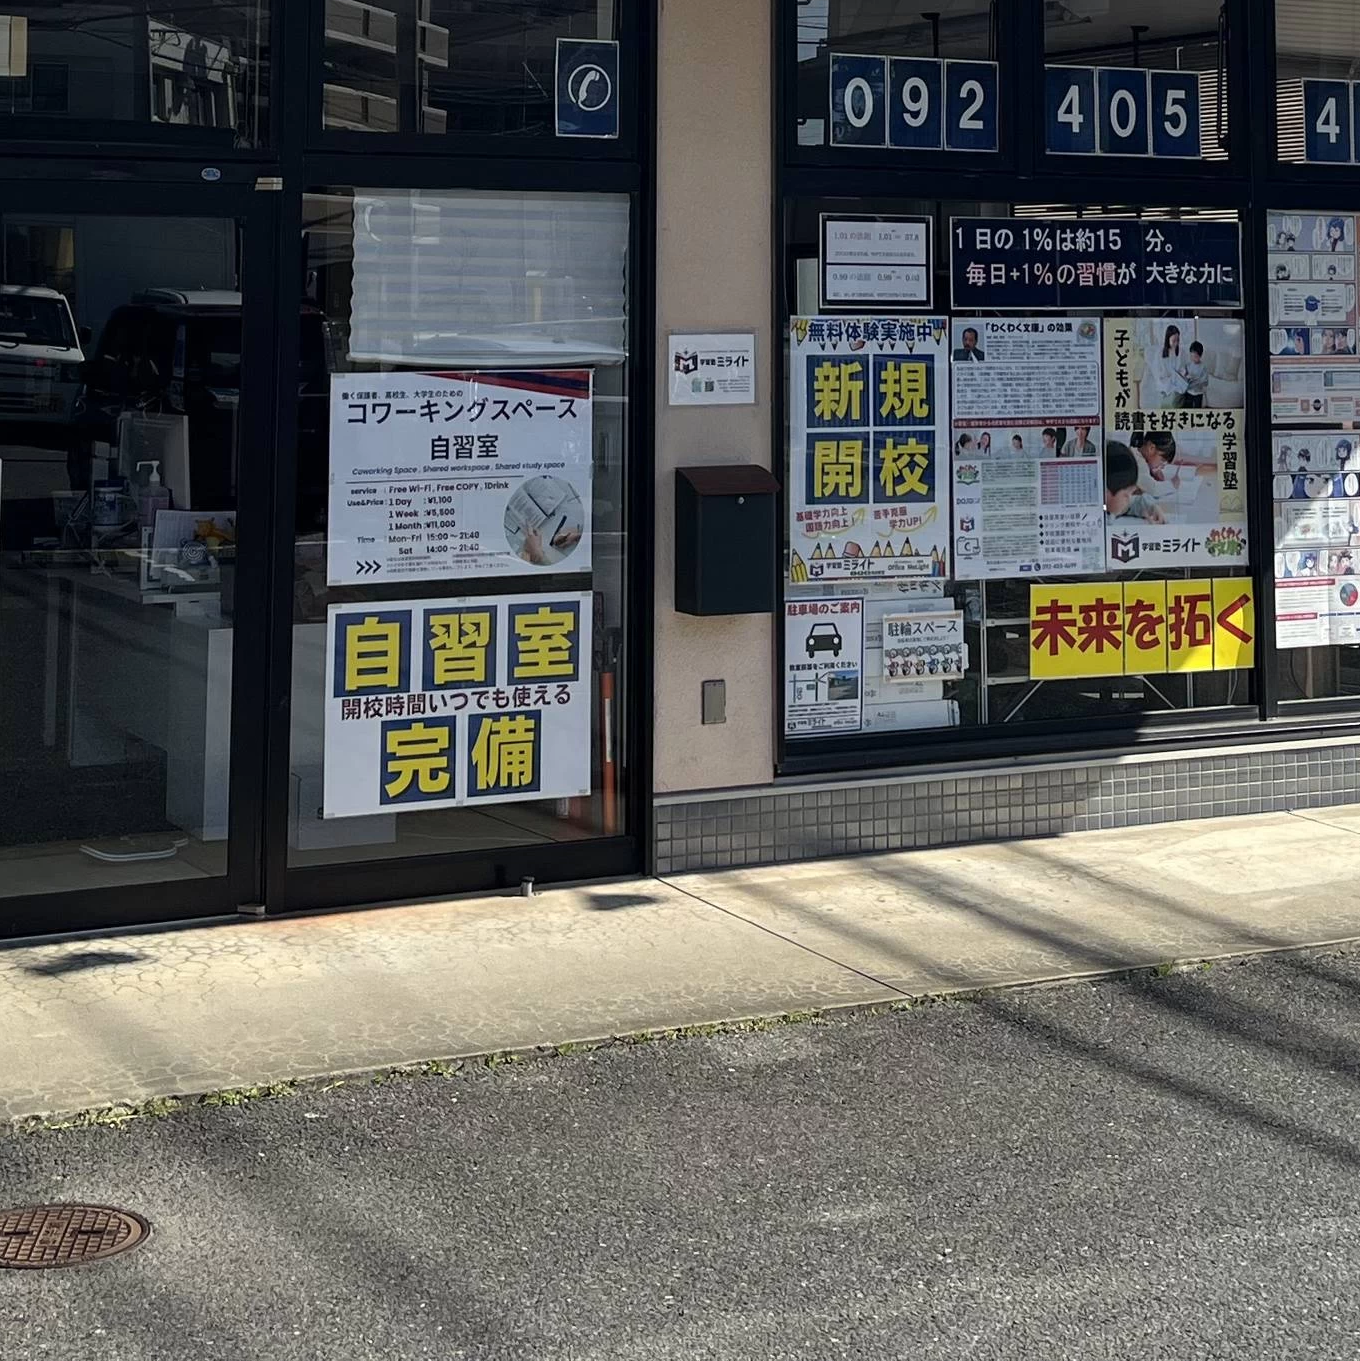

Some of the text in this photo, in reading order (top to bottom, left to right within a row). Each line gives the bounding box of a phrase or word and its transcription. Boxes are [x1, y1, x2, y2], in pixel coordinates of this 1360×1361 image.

[1145, 261, 1234, 284] 大きな力に
[808, 322, 933, 342] 無料体験実施中
[717, 355, 750, 368] ミライト
[1114, 329, 1131, 408] 子どもが
[813, 361, 930, 421] 新規
[347, 397, 578, 425] コワーキングスペース
[1114, 411, 1236, 431] 読書を好きになる
[430, 434, 499, 461] 自習室
[422, 464, 449, 473] Shared
[495, 461, 521, 471] Shared
[522, 461, 543, 471] study
[813, 437, 930, 499] 開校
[1222, 432, 1239, 491] 学習塾
[389, 486, 408, 494] Free
[395, 498, 412, 507] Day
[395, 510, 419, 518] Week
[795, 506, 849, 522] 基礎学力向上
[395, 522, 422, 530] Month
[398, 547, 413, 555] Sat
[1162, 538, 1201, 552] ミライト
[843, 557, 875, 571] ミライト
[787, 602, 861, 617] 駐車場のご案内
[887, 620, 958, 637] 駐輪スペース
[1031, 593, 1253, 656] 未来を拓く
[345, 607, 575, 691] 自習室
[341, 684, 572, 721] 開校時間いつでも使える
[384, 715, 535, 798] 完備
